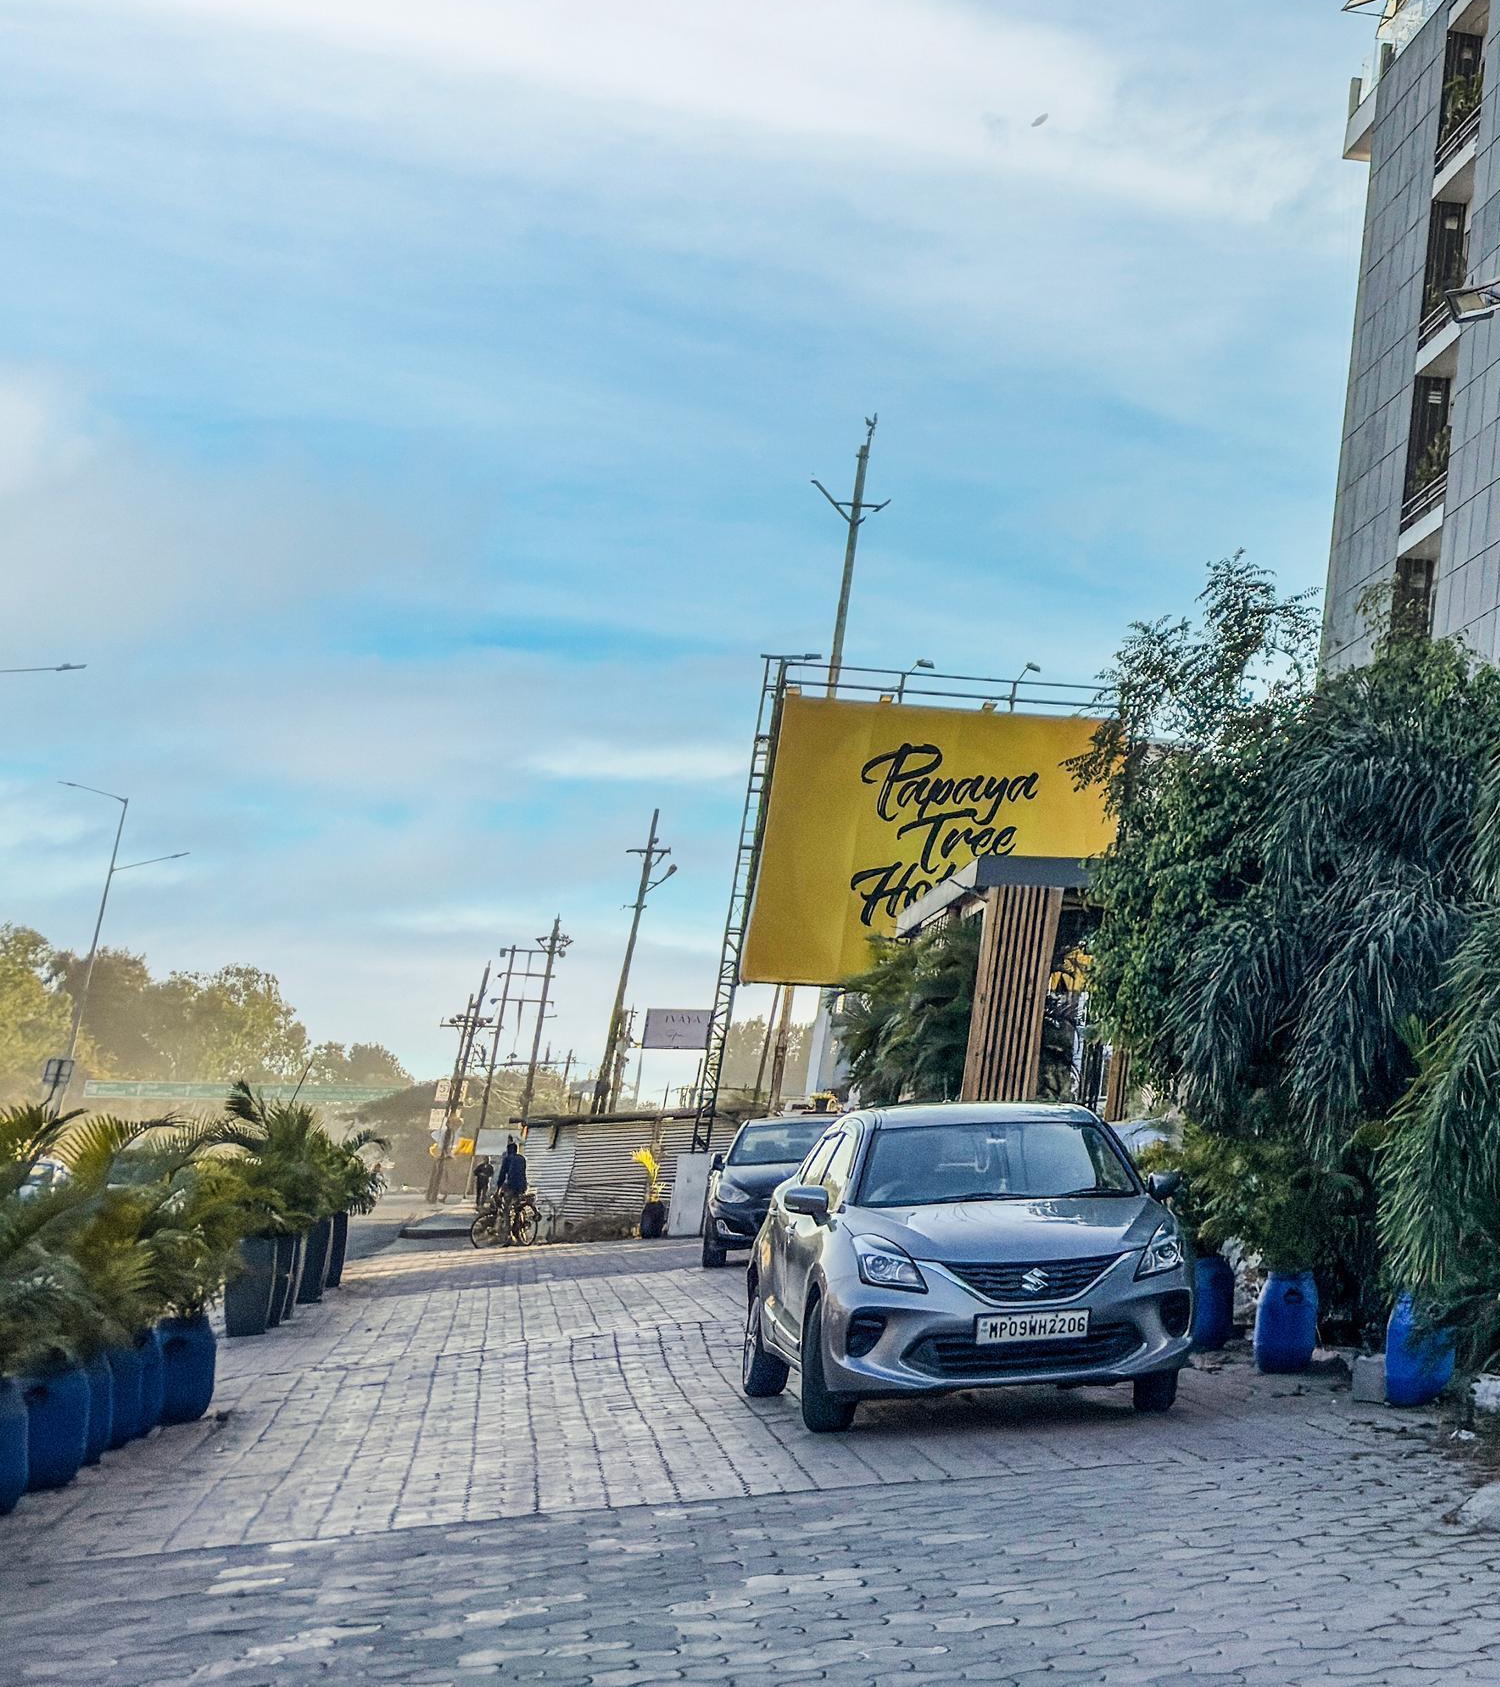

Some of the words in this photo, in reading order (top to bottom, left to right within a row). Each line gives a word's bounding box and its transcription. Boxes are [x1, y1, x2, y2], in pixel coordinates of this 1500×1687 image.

[861, 742, 1039, 825] Papaya
[897, 808, 1018, 874] Tree
[989, 1316, 1086, 1339] MP09WH2206
